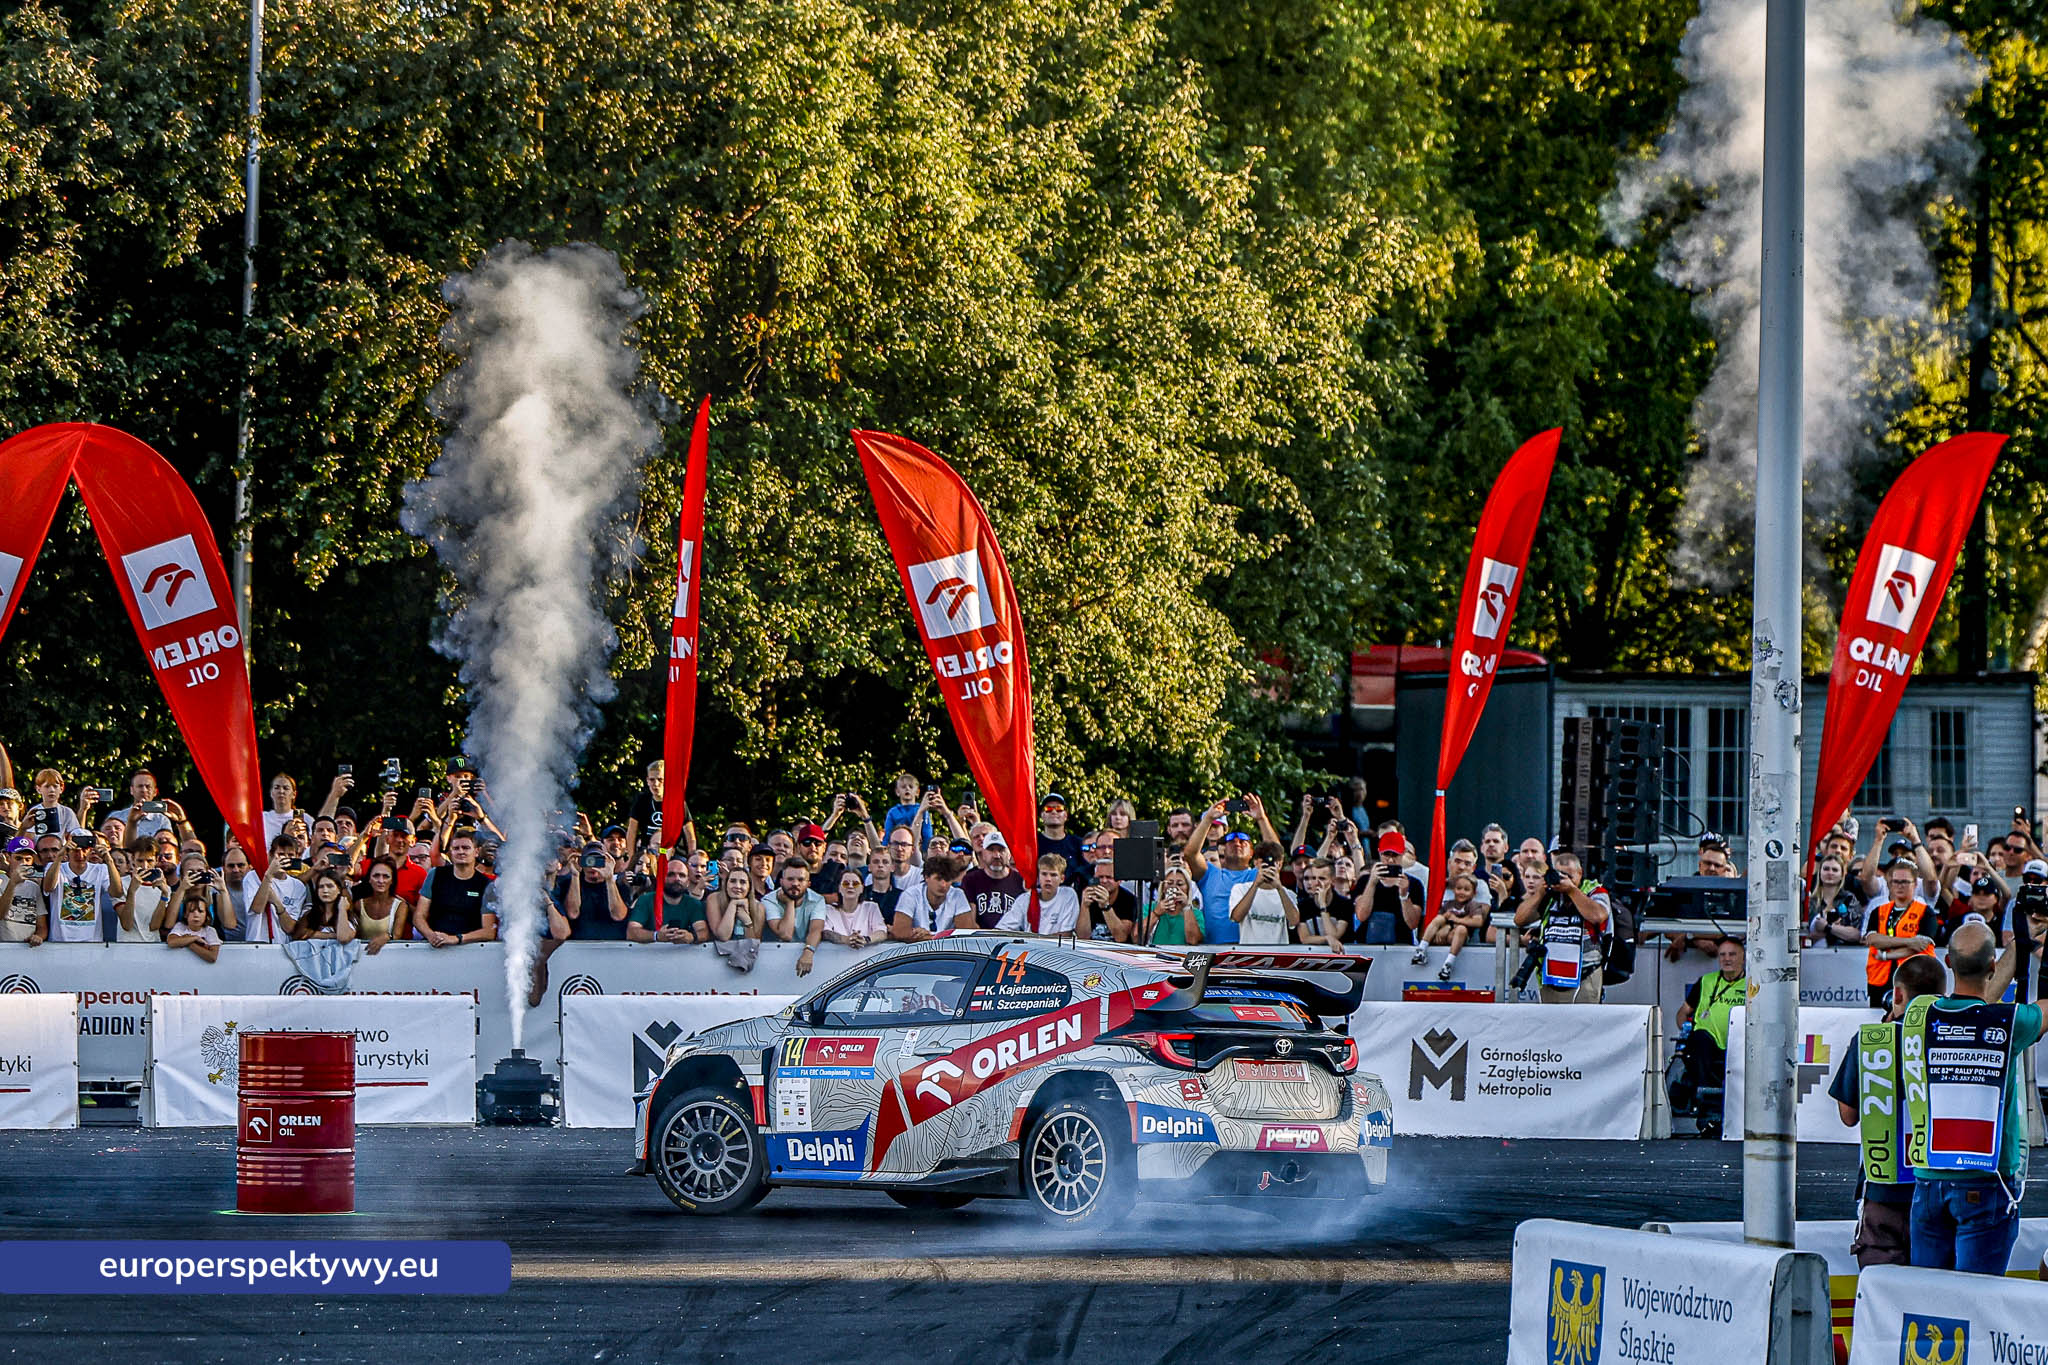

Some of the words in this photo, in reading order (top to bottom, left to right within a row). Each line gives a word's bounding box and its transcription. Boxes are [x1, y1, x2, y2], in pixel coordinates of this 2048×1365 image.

[1856, 668, 1882, 692] OIL
[996, 951, 1028, 984] 14
[985, 985, 996, 996] K.
[998, 983, 1067, 997] Kajetanowicz
[981, 1000, 994, 1011] M.
[997, 998, 1061, 1011] Szczepaniak
[1938, 1025, 1976, 1035] ERC
[1985, 1030, 2004, 1041] FIA
[784, 1038, 805, 1066] 14
[840, 1044, 865, 1052] ORLEN
[972, 1014, 1083, 1080] ORLEN
[1480, 1047, 1563, 1066] Górnośląsko
[1931, 1052, 2002, 1063] PHOTOGRAPHER
[355, 1049, 429, 1069] urystyki
[1904, 1033, 1927, 1103] 248
[1862, 1048, 1893, 1116] 276
[1954, 1067, 1974, 1075] RALLY
[1974, 1067, 2000, 1077] POLAND
[1478, 1082, 1552, 1098] Metropolia
[279, 1115, 321, 1126] ORLEN
[1142, 1115, 1204, 1137] Delphi
[279, 1128, 295, 1136] OIL
[1365, 1120, 1391, 1144] Delphi
[1911, 1114, 1926, 1163] POL
[787, 1137, 855, 1166] Delphi
[1867, 1129, 1890, 1179] POL
[1622, 1277, 1733, 1324] Województwo
[1619, 1320, 1675, 1365] Śląskie
